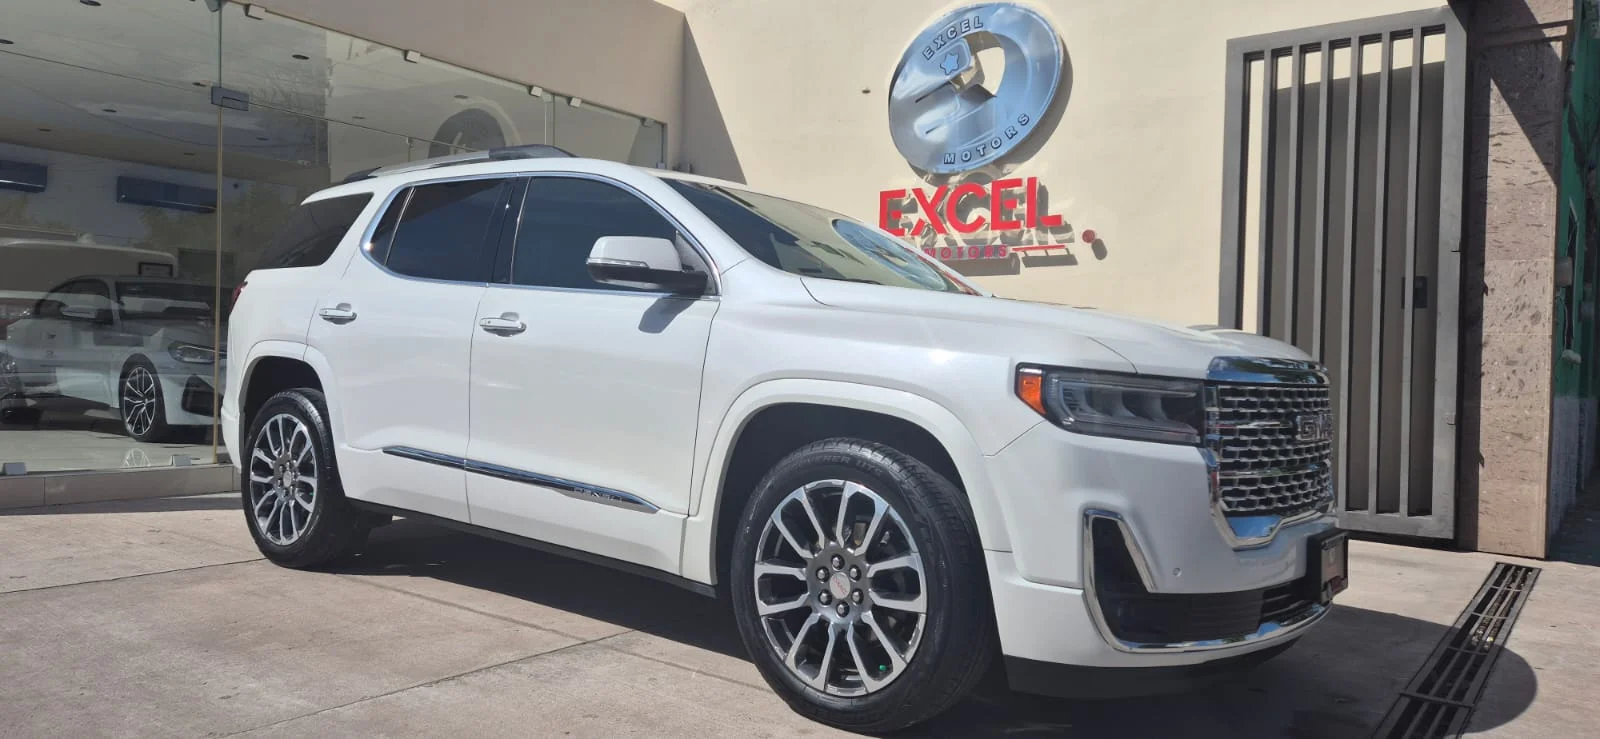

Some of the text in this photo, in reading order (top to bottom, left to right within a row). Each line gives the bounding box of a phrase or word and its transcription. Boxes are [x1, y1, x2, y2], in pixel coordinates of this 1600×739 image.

[922, 16, 983, 60] EXCEL
[944, 113, 1030, 165] MOTORS
[879, 177, 1063, 237] EXCEL
[924, 244, 1008, 260] MOTORS
